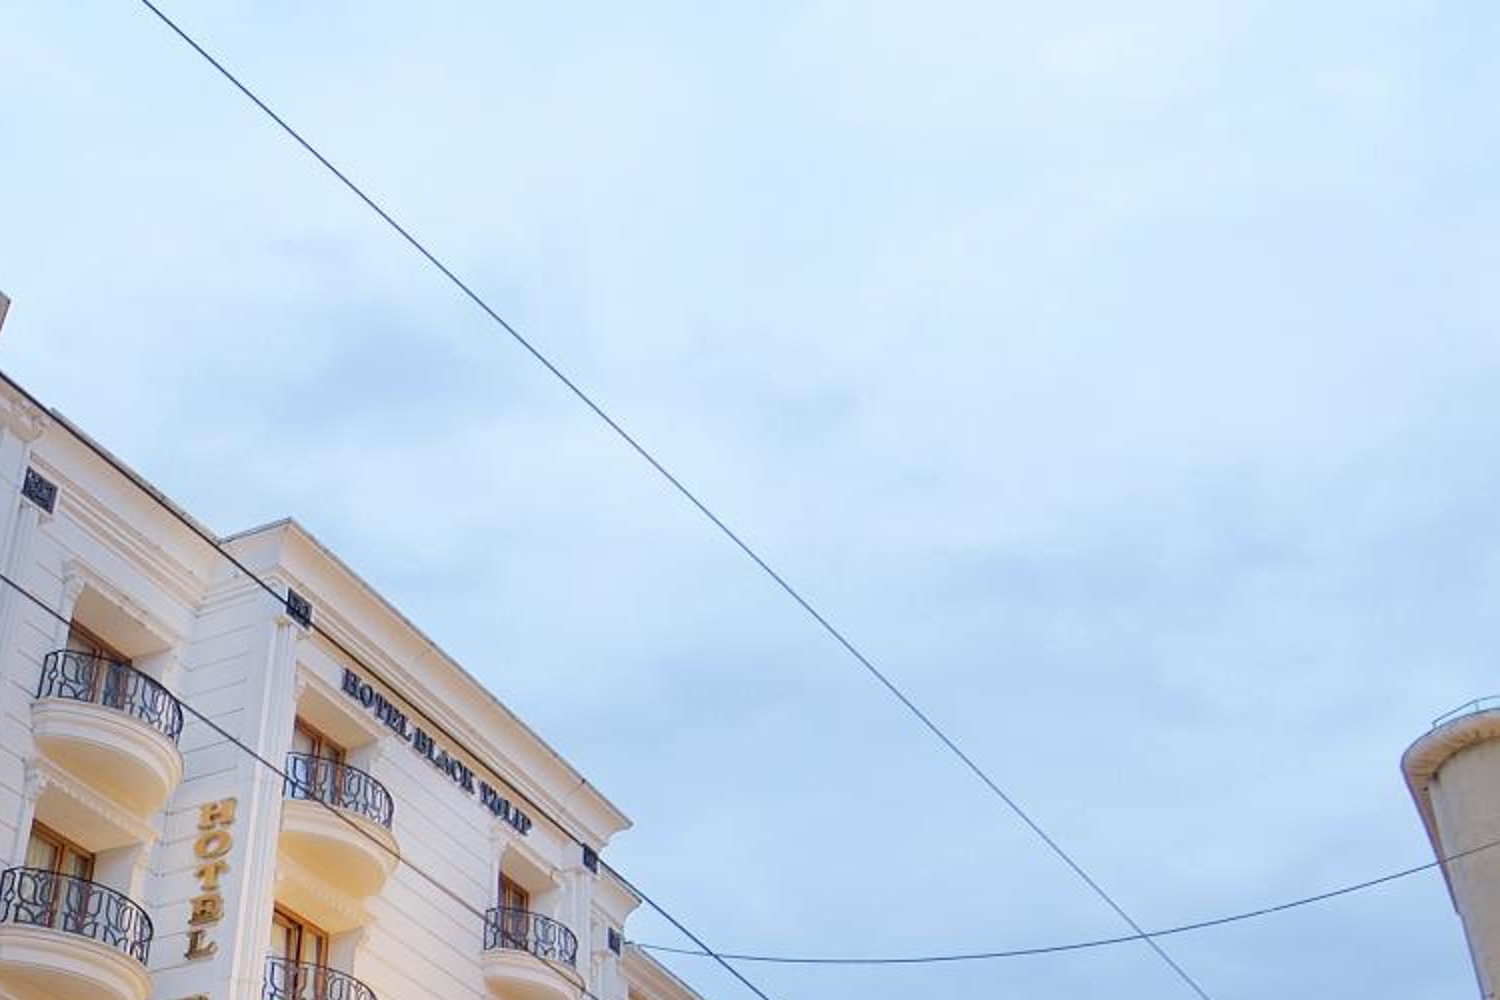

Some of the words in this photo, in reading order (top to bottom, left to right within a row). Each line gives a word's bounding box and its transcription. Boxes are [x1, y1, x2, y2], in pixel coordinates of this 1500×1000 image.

[341, 667, 412, 742] HOTEL
[412, 727, 476, 795] BLACK
[478, 780, 533, 837] TULIP
[185, 797, 237, 961] HOTEL
